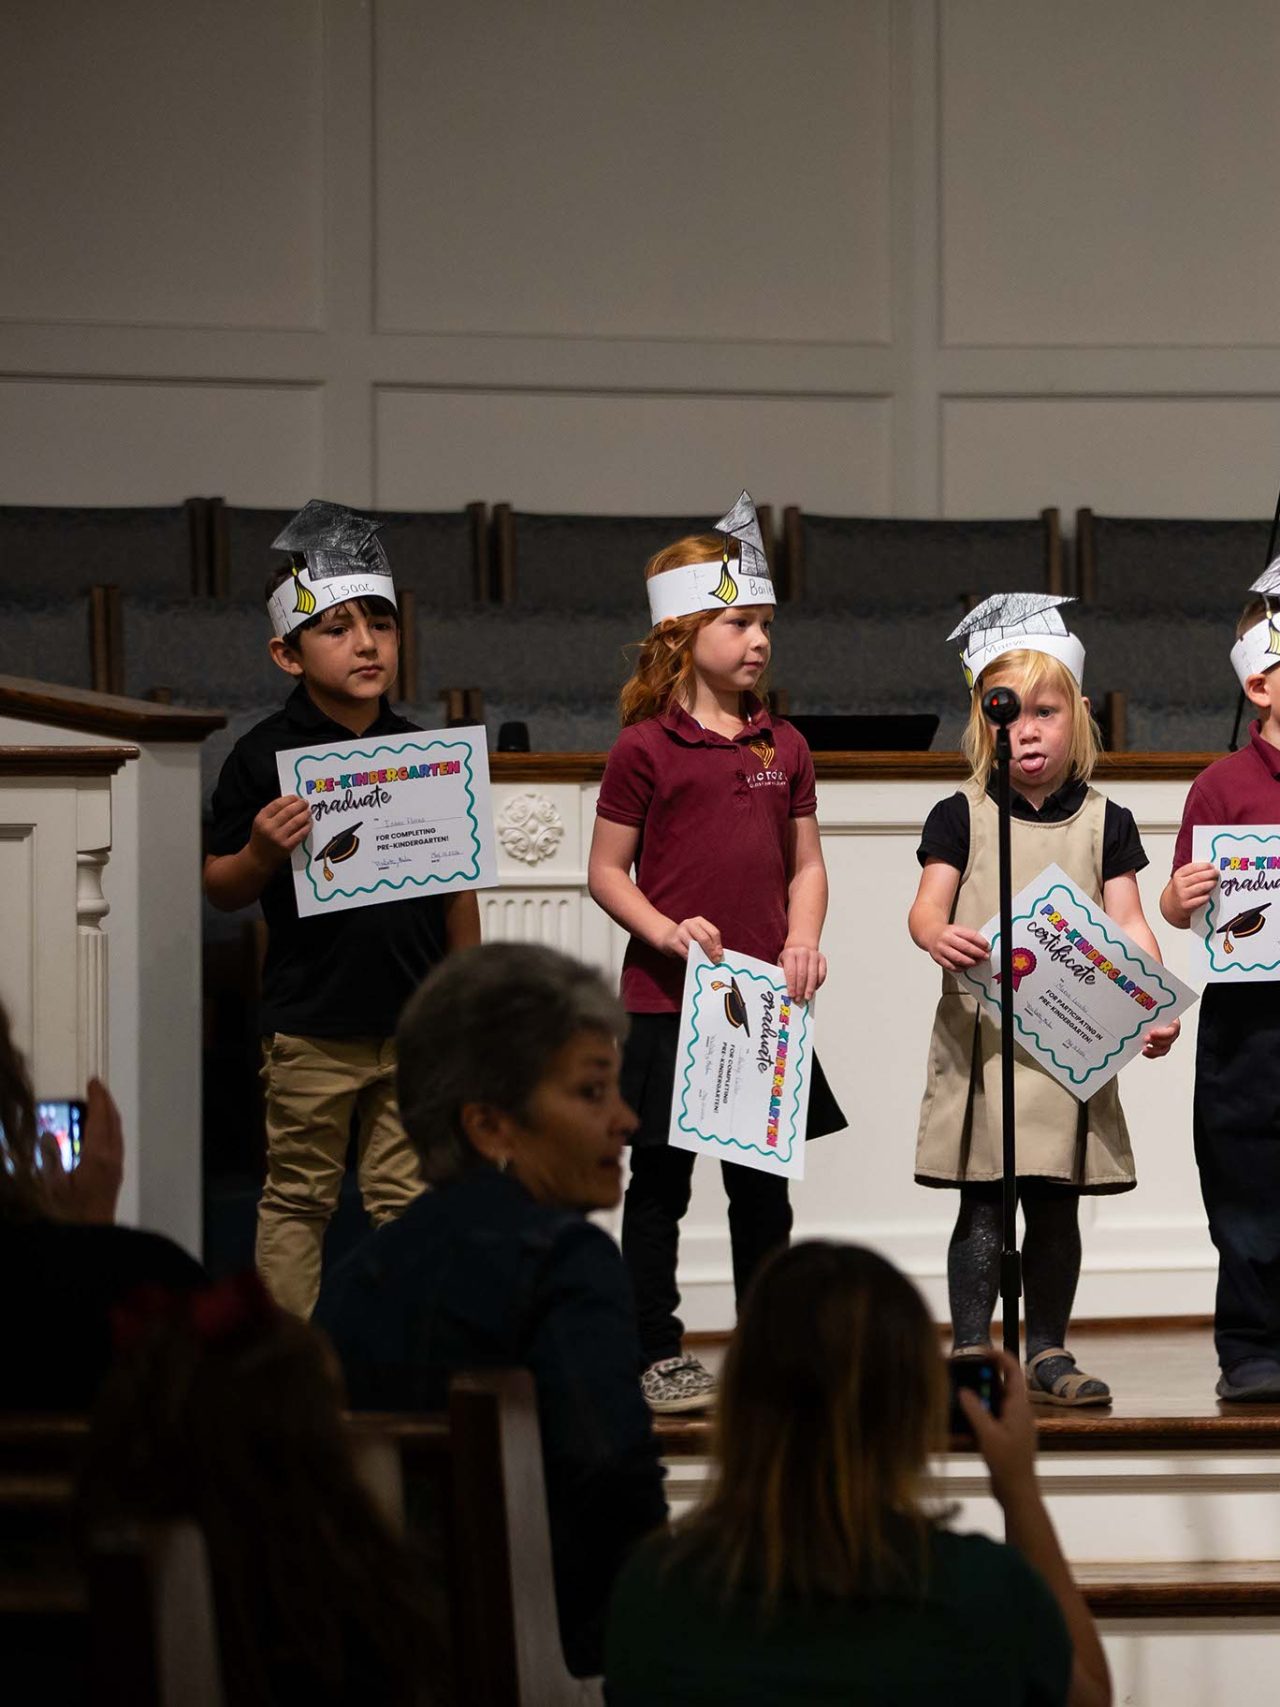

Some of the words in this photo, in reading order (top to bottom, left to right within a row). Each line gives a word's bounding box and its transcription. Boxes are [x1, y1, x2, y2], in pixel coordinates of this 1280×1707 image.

[323, 583, 375, 603] Isaac
[305, 760, 461, 795] PRE-KINDERGARTEN
[310, 785, 392, 821] graduate
[376, 833, 390, 842] FOR
[390, 827, 436, 840] COMPLETING
[376, 835, 449, 851] PRE-KINDERGARTEN!
[1026, 921, 1096, 986] certificate
[1039, 903, 1159, 1011] PRE-KINDERGARTEN
[757, 990, 778, 1074] graduate
[1039, 995, 1093, 1044] PRE-KINDERGARTEN!
[1045, 989, 1058, 1001] FOR
[1056, 999, 1097, 1035] PARTICIPATING
[1095, 1032, 1103, 1041] IN
[722, 1059, 733, 1104] COMPLETING
[766, 994, 792, 1148] PRE-KINDERGARTEN
